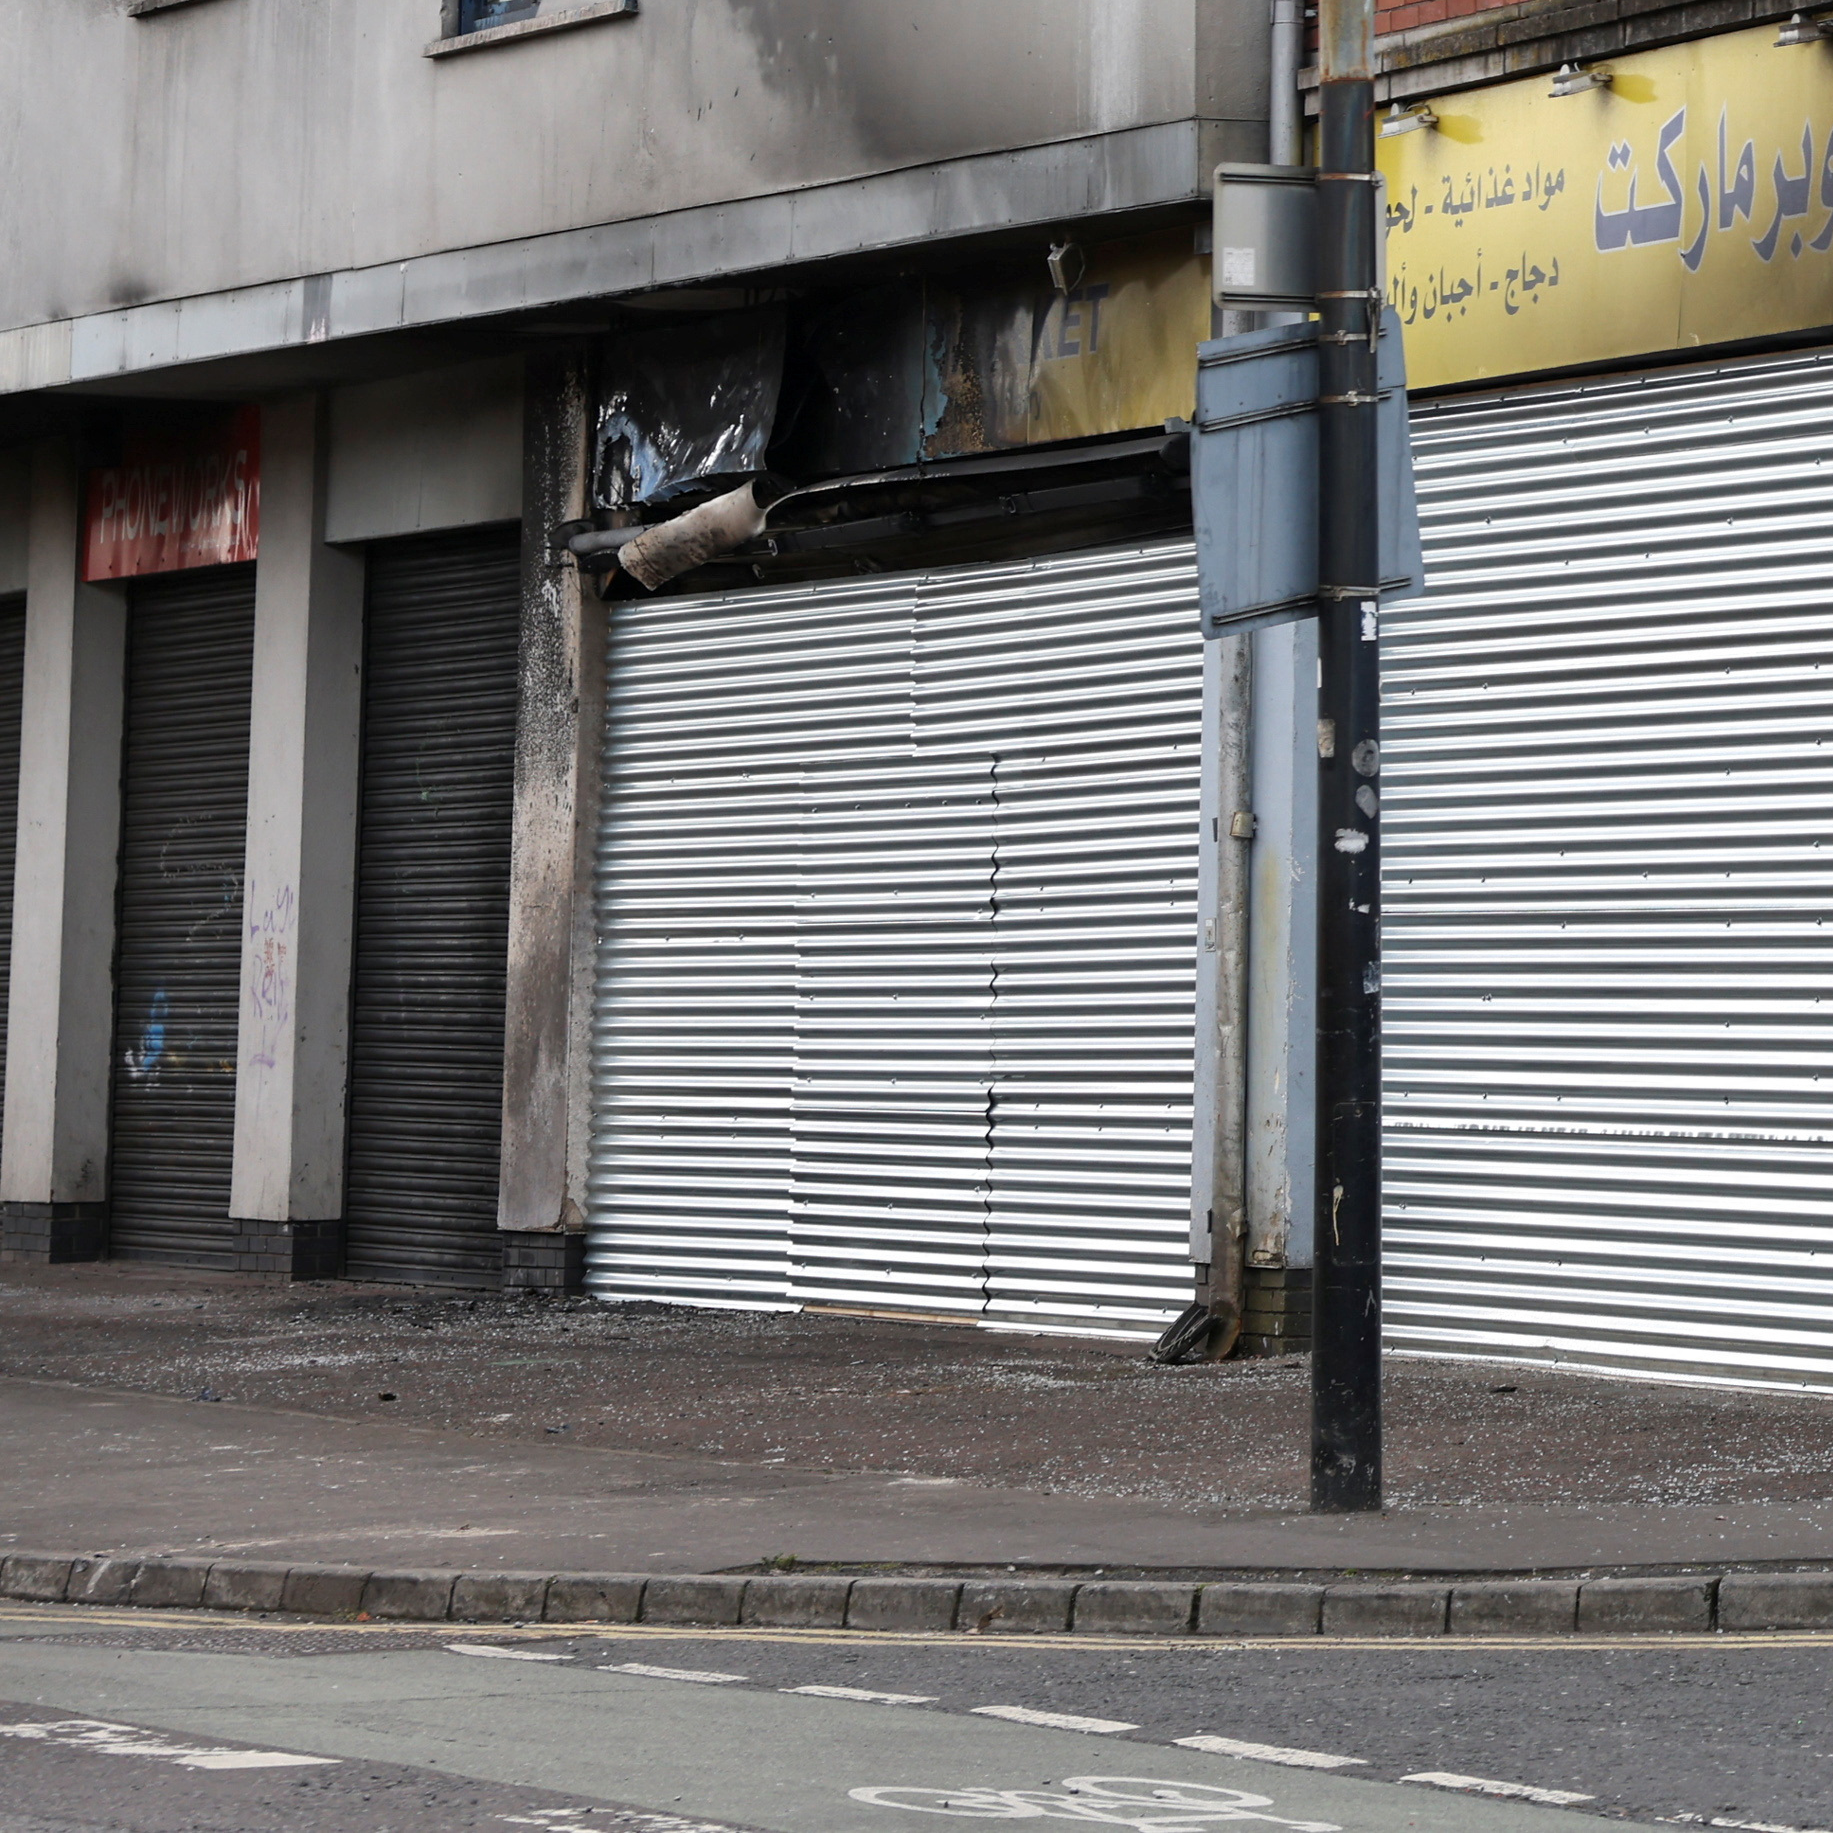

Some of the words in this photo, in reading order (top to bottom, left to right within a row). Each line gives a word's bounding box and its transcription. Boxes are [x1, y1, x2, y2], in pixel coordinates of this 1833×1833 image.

[1441, 163, 1516, 228] غذائية
[1522, 162, 1565, 211] مواد
[1422, 247, 1483, 323] أجبان
[1505, 250, 1559, 316] دجاج
